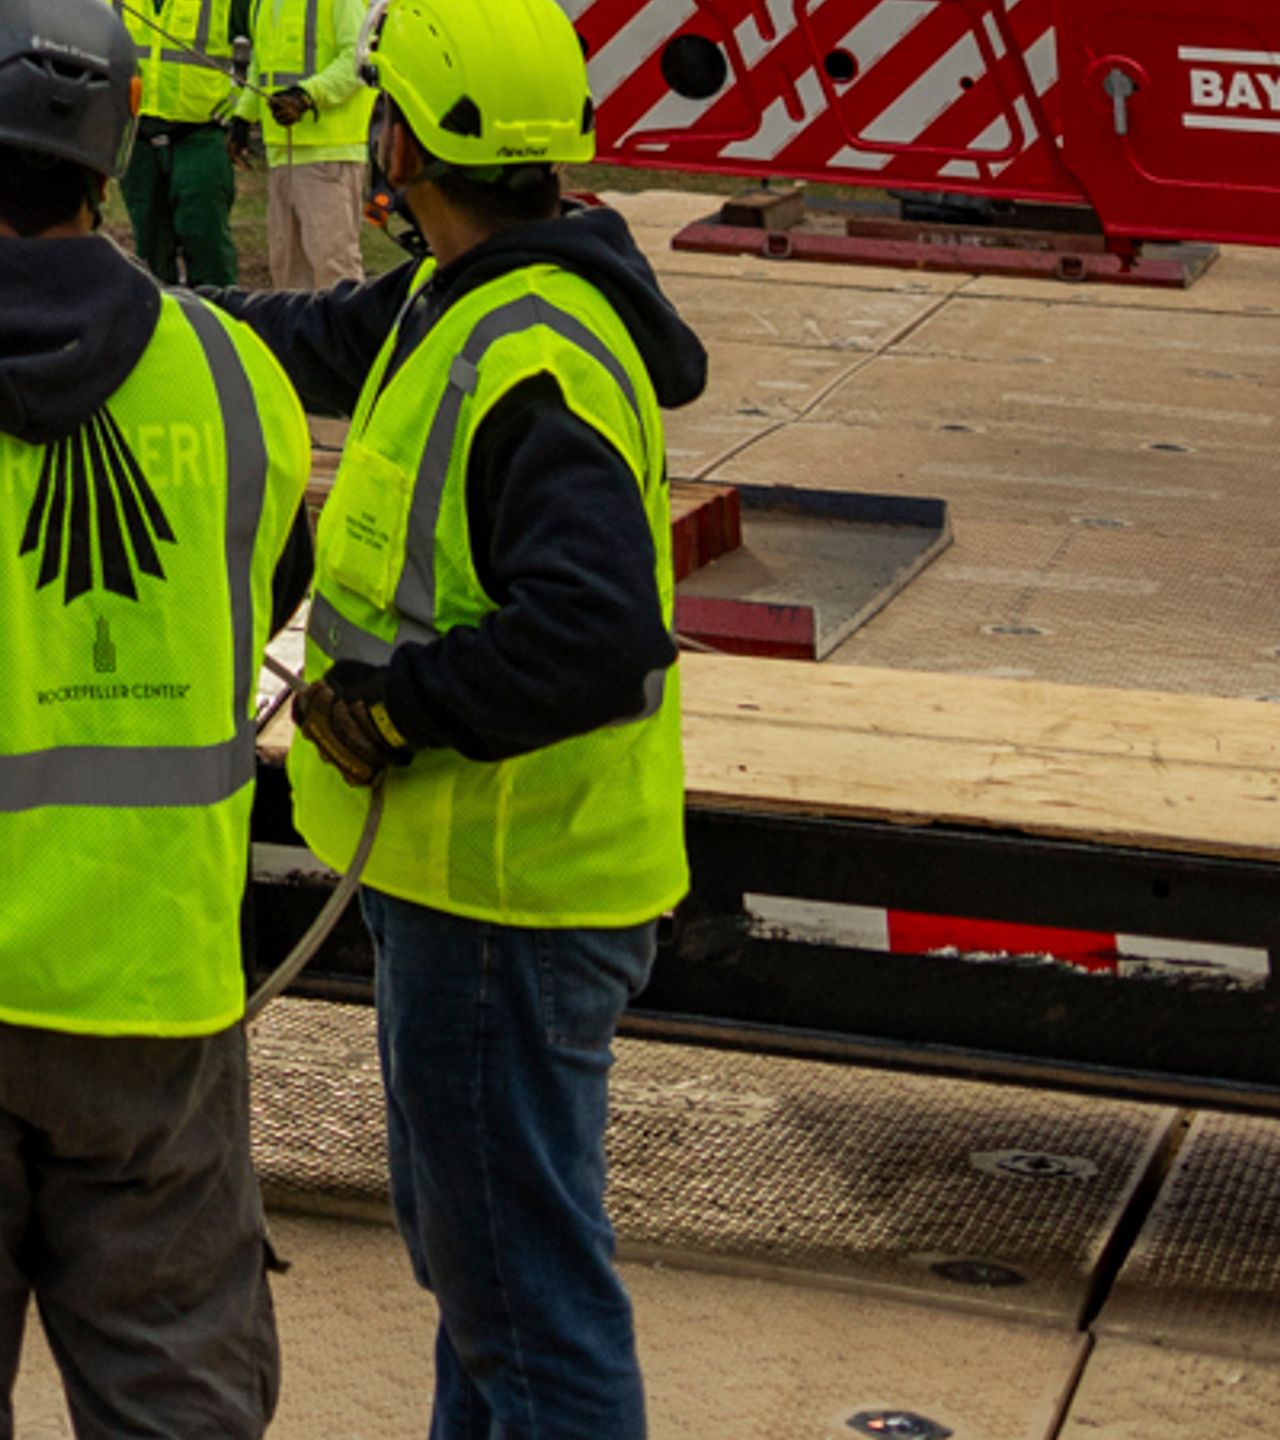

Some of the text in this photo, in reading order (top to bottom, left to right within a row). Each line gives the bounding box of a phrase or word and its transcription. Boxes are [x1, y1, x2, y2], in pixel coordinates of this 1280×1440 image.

[1189, 68, 1280, 110] BAY
[37, 683, 187, 705] ROCKEFELLER CENTER
